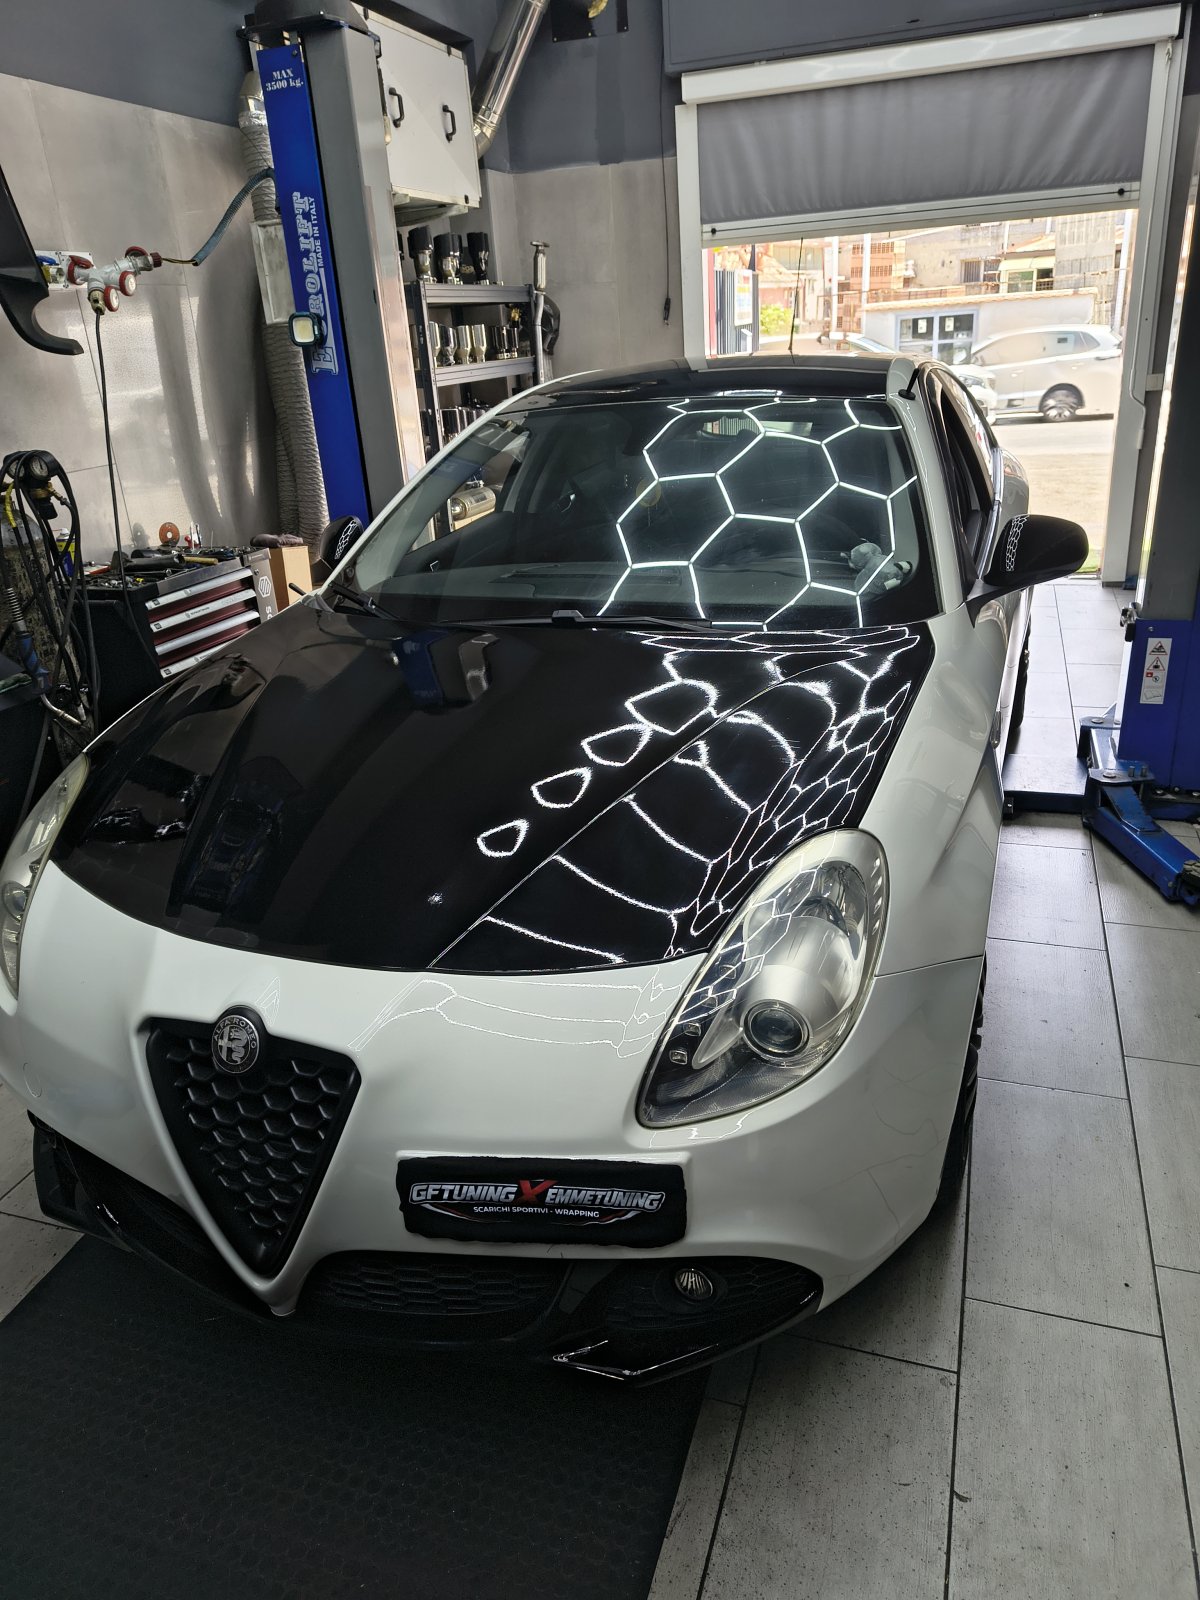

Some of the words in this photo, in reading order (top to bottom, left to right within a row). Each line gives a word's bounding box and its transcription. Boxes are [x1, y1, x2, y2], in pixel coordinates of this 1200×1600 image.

[265, 79, 288, 91] 3500
[289, 77, 304, 88] kg.
[272, 68, 294, 80] MAX
[308, 196, 318, 224] ITALY
[313, 226, 320, 237] IN
[315, 239, 324, 267] MADE
[213, 1019, 231, 1042] ALFA
[232, 1017, 257, 1049] ROMEO
[412, 1184, 518, 1203] GFTUNING
[544, 1188, 662, 1210] EMMETUNING
[512, 1206, 549, 1214] SPORTIVI
[554, 1208, 600, 1218] WRAPPING
